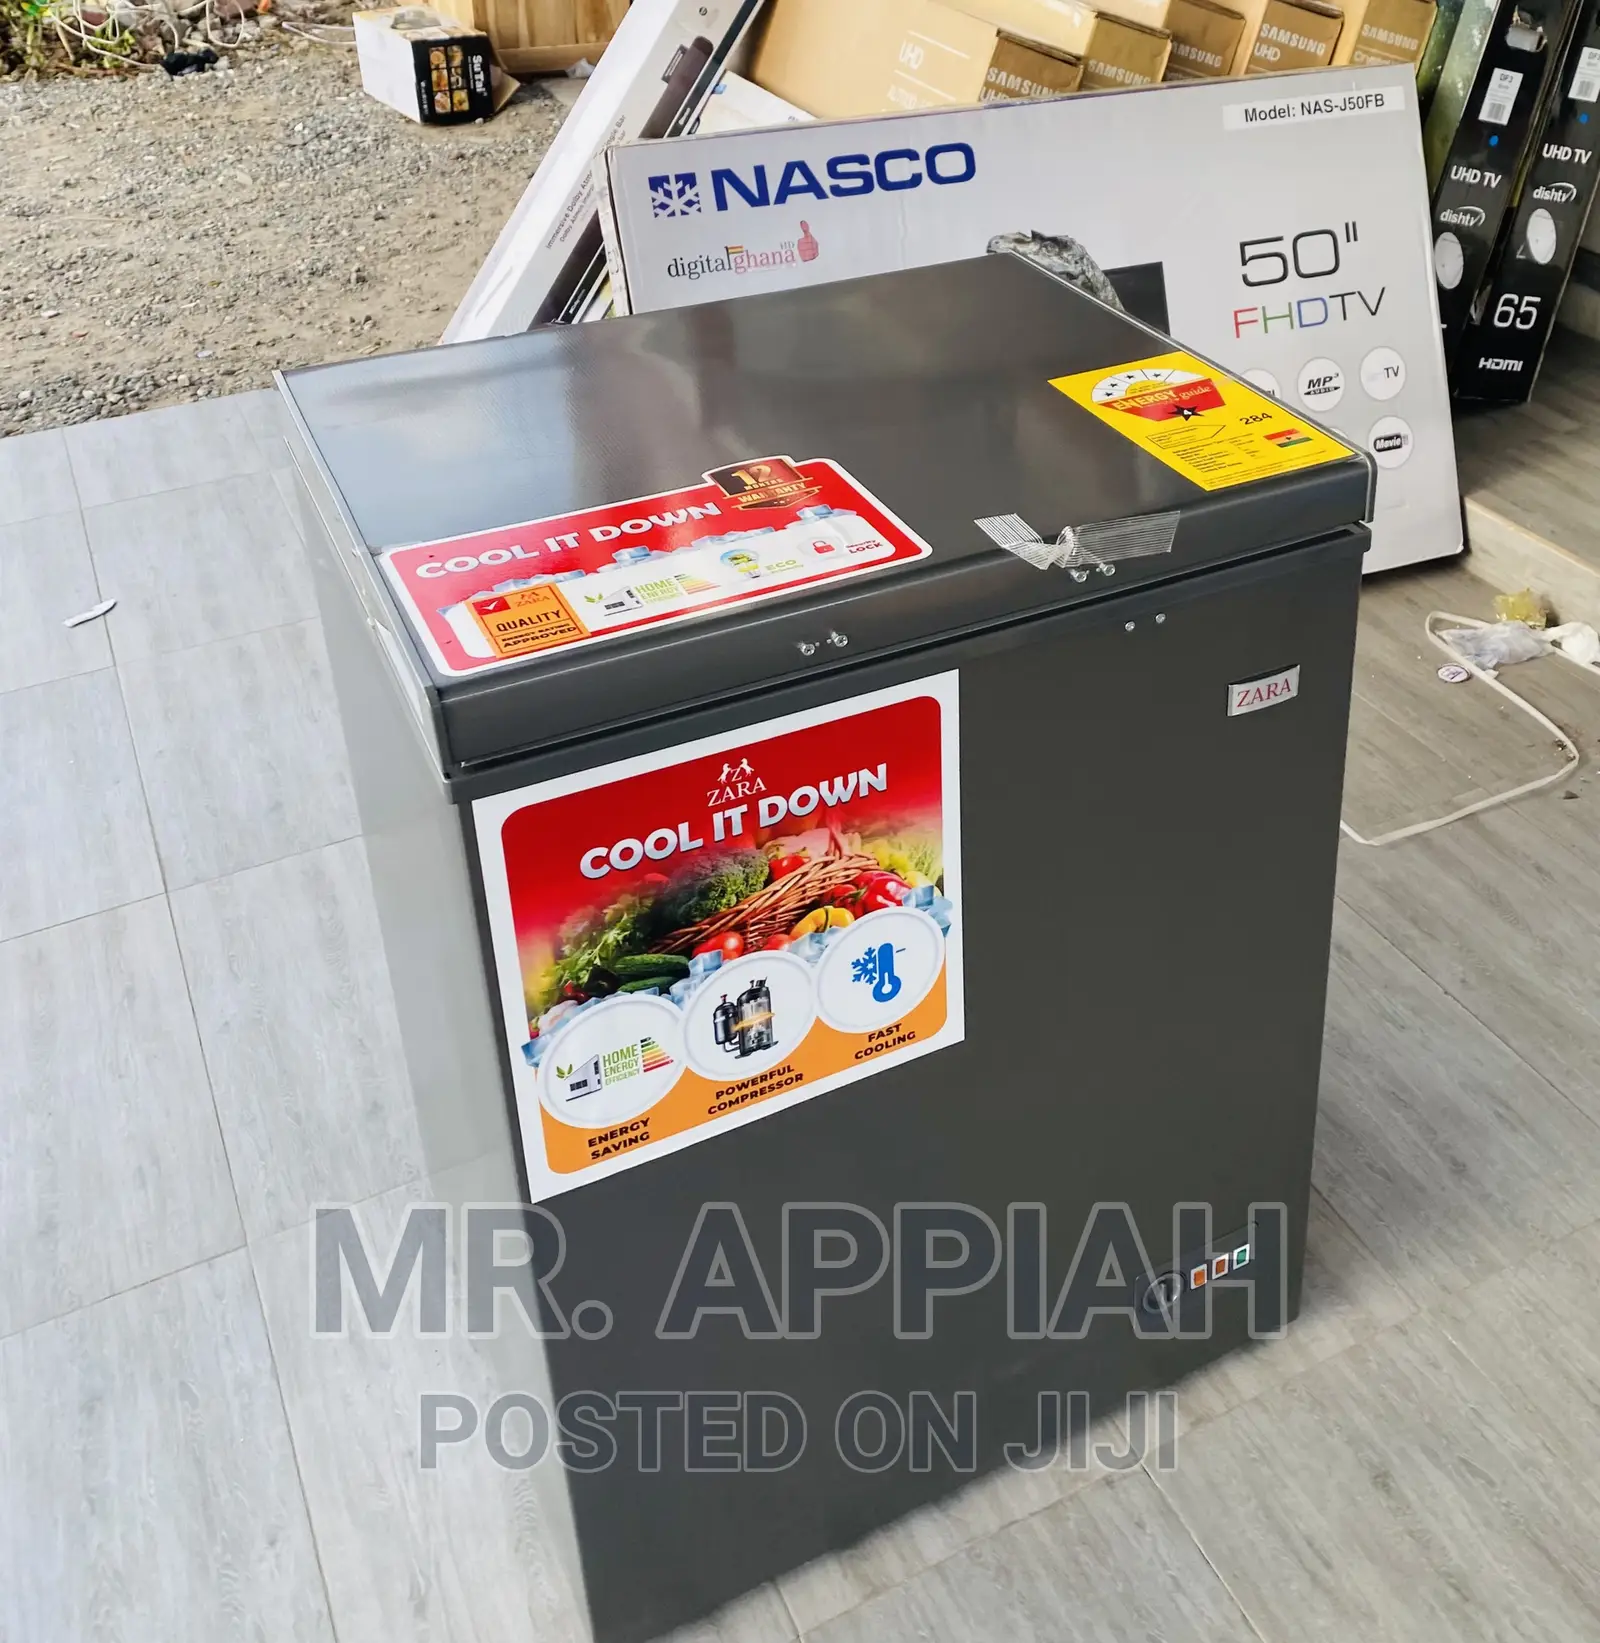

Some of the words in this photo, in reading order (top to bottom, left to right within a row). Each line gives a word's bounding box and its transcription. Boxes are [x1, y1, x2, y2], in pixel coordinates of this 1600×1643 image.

[1260, 23, 1326, 56] SAMSUNG
[1362, 23, 1419, 51] SAMSUNG
[1172, 41, 1223, 68] AMSUNG
[1254, 42, 1281, 62] UHD
[1244, 104, 1296, 122] Model:
[1301, 93, 1385, 116] NAS-J50FB
[1542, 143, 1571, 161] UHD
[1574, 149, 1592, 165] TV
[710, 142, 976, 212] NASCO
[1450, 165, 1481, 184] UHD
[1483, 172, 1502, 188] TV
[567, 190, 584, 213] Dolby
[1239, 221, 1358, 287] 50"
[1233, 286, 1386, 338] FHDTV
[1493, 294, 1541, 329] 65
[1384, 365, 1400, 379] TV
[1479, 357, 1523, 371] HDMI
[1112, 390, 1179, 410] ENERGY
[1179, 386, 1212, 400] guide
[1240, 412, 1273, 425] 284
[731, 465, 771, 486] 12
[415, 545, 540, 578] COOL
[544, 532, 580, 553] IT
[588, 502, 722, 542] DOWN
[849, 542, 883, 554] LOCK
[766, 559, 796, 571] ECO
[635, 578, 674, 593] HOME
[496, 609, 561, 632] QUALITY
[503, 627, 577, 648] APPROVED
[1236, 678, 1291, 707] ZARA
[706, 777, 767, 807] ZARA
[579, 821, 704, 879] COOL
[713, 804, 748, 842] IT
[758, 763, 888, 828] DOWN
[867, 1022, 902, 1042] FAST
[603, 1044, 639, 1067] HOME
[854, 1030, 916, 1060] COOLING
[604, 1057, 639, 1077] ENERGY
[707, 1072, 804, 1115] COMPRESSOR
[715, 1064, 795, 1100] POWERFUL
[587, 1117, 651, 1147] ENERGY
[590, 1131, 650, 1160] SAVING
